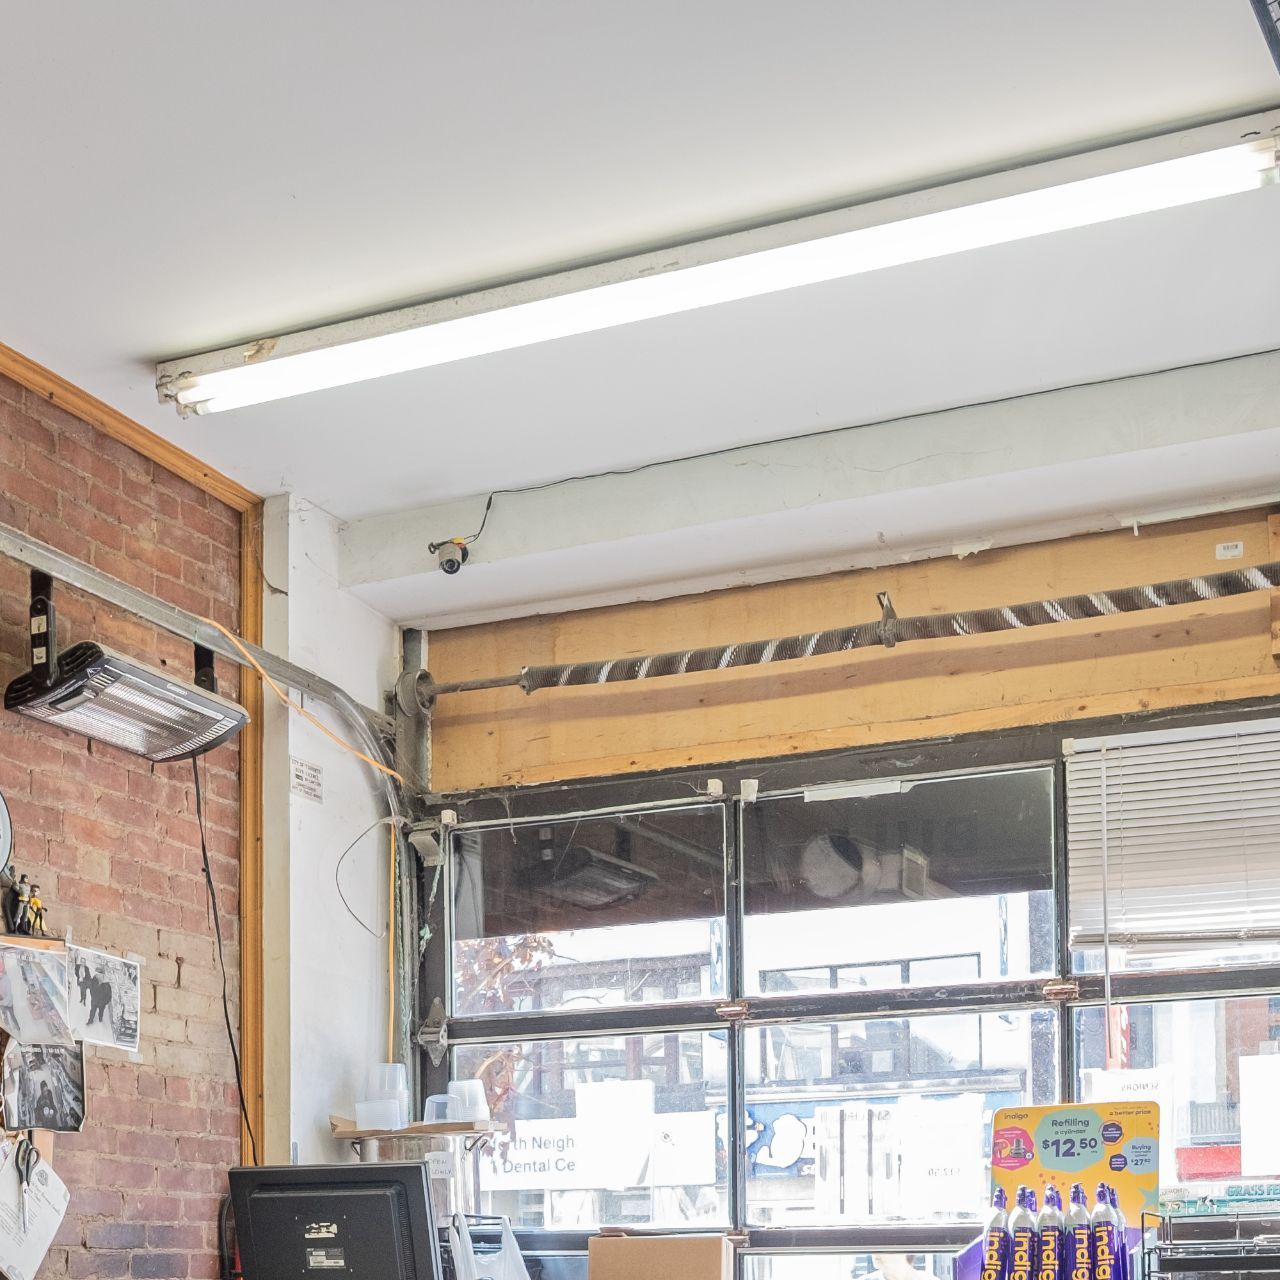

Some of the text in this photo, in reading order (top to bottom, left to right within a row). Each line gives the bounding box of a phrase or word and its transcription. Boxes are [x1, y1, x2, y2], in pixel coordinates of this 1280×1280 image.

[1004, 1112, 1029, 1121] indigo
[1051, 1118, 1090, 1128] Refilling
[532, 1135, 575, 1152] Neigh
[1042, 1137, 1098, 1158] $12.50
[503, 1159, 550, 1174] Dental
[1226, 1184, 1264, 1197] GRASS
